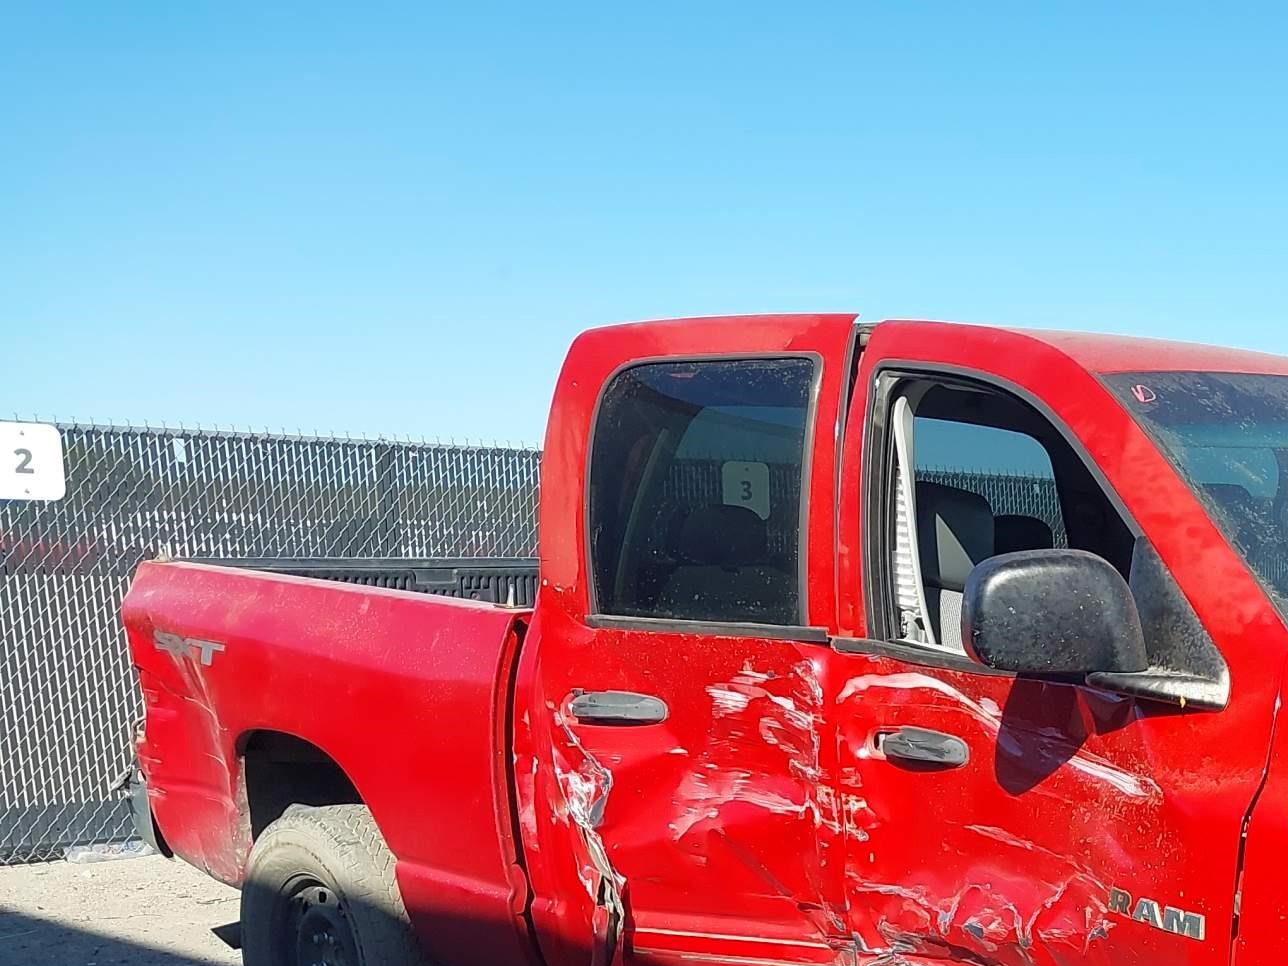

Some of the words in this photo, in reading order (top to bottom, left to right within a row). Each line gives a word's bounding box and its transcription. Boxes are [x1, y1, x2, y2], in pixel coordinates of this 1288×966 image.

[13, 447, 35, 474] 2
[739, 480, 753, 501] 3
[153, 629, 227, 667] SXT
[1108, 886, 1206, 941] RAM
